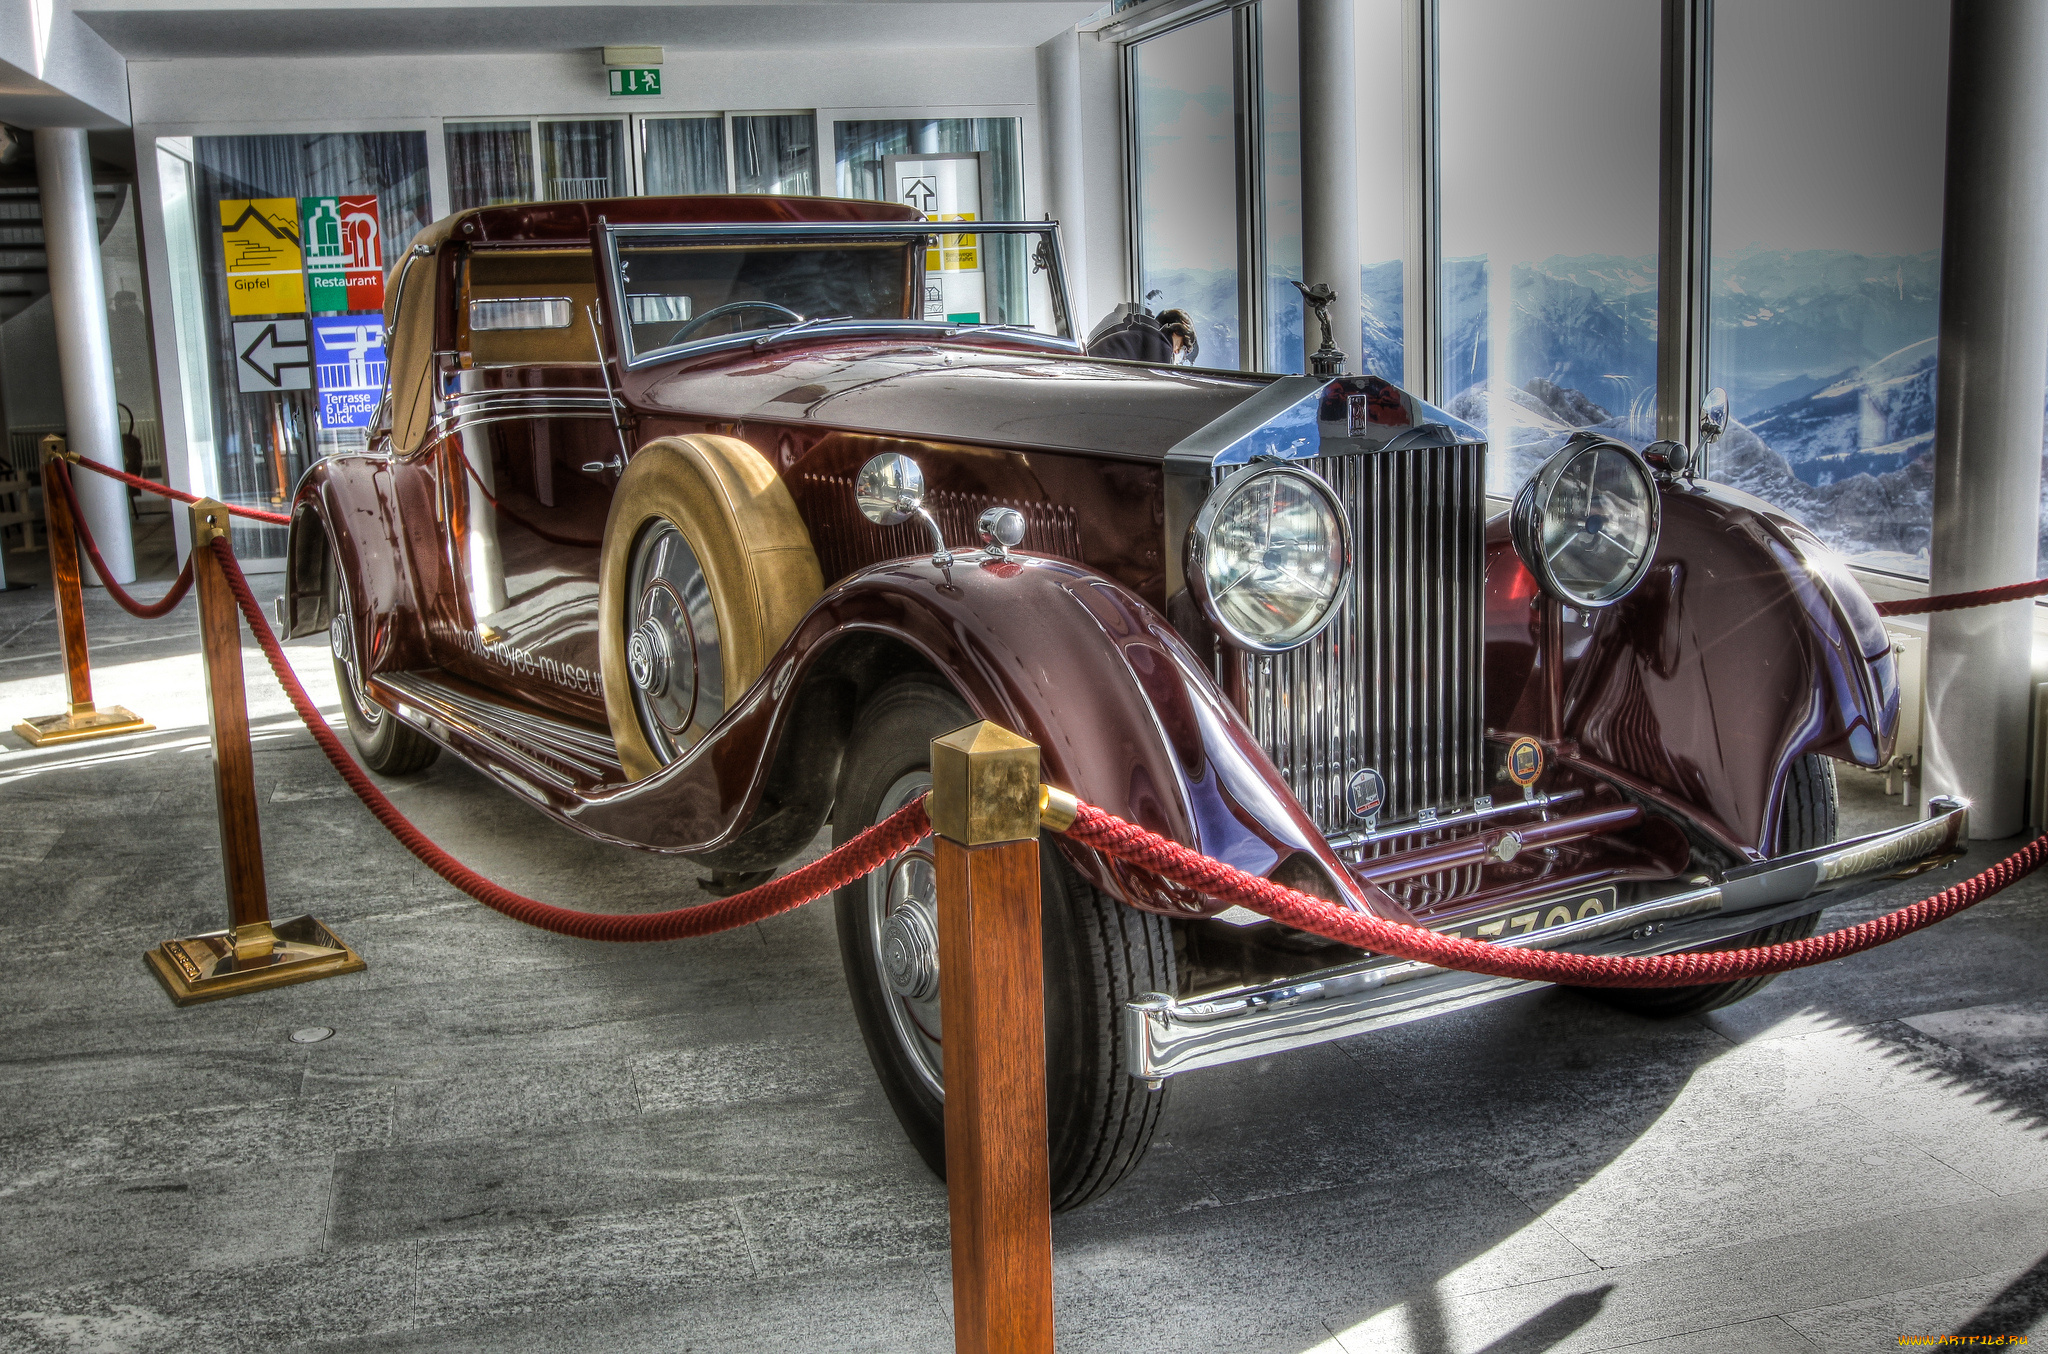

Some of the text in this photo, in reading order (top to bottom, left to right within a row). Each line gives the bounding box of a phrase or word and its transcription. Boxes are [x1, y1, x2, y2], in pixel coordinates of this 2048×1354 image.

[234, 278, 270, 291] Gipfel
[314, 275, 377, 288] Restaurant
[324, 393, 371, 404] Terrasse
[325, 403, 334, 414] 6
[327, 412, 354, 425] blick
